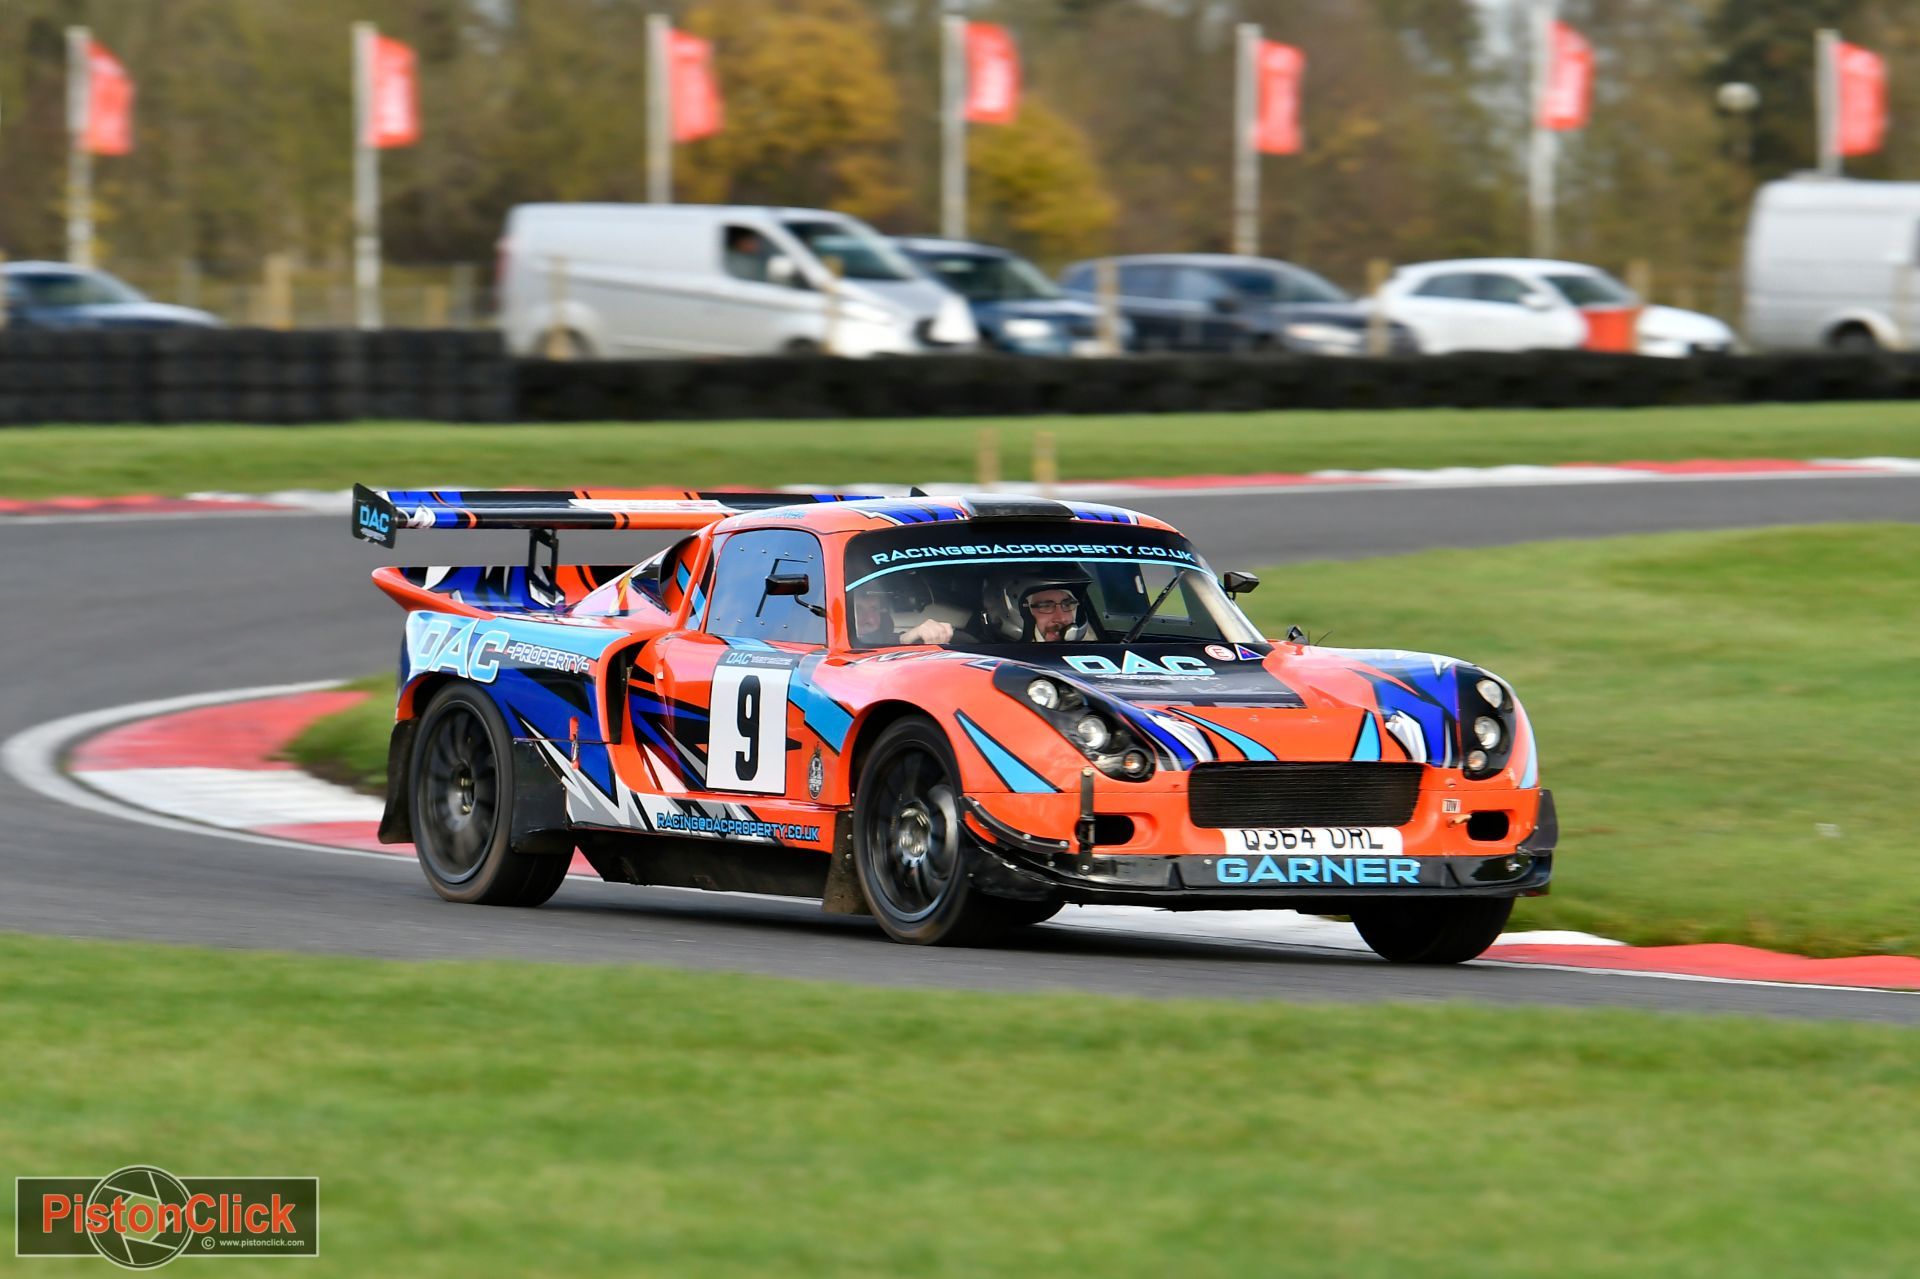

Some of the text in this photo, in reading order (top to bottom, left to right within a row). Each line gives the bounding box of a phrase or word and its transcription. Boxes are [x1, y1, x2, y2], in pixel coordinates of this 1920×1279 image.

[360, 505, 389, 533] DAC
[871, 544, 1197, 565] RACING@DACPROPERTY.CO.UK
[412, 619, 510, 684] DAC
[726, 652, 753, 665] DAC
[1062, 650, 1215, 675] DAC
[735, 675, 761, 781] 9
[656, 812, 821, 842] RACING@DACPROPERTY.CO.UK
[1239, 828, 1316, 851] Q364
[1215, 855, 1421, 886] GARNER
